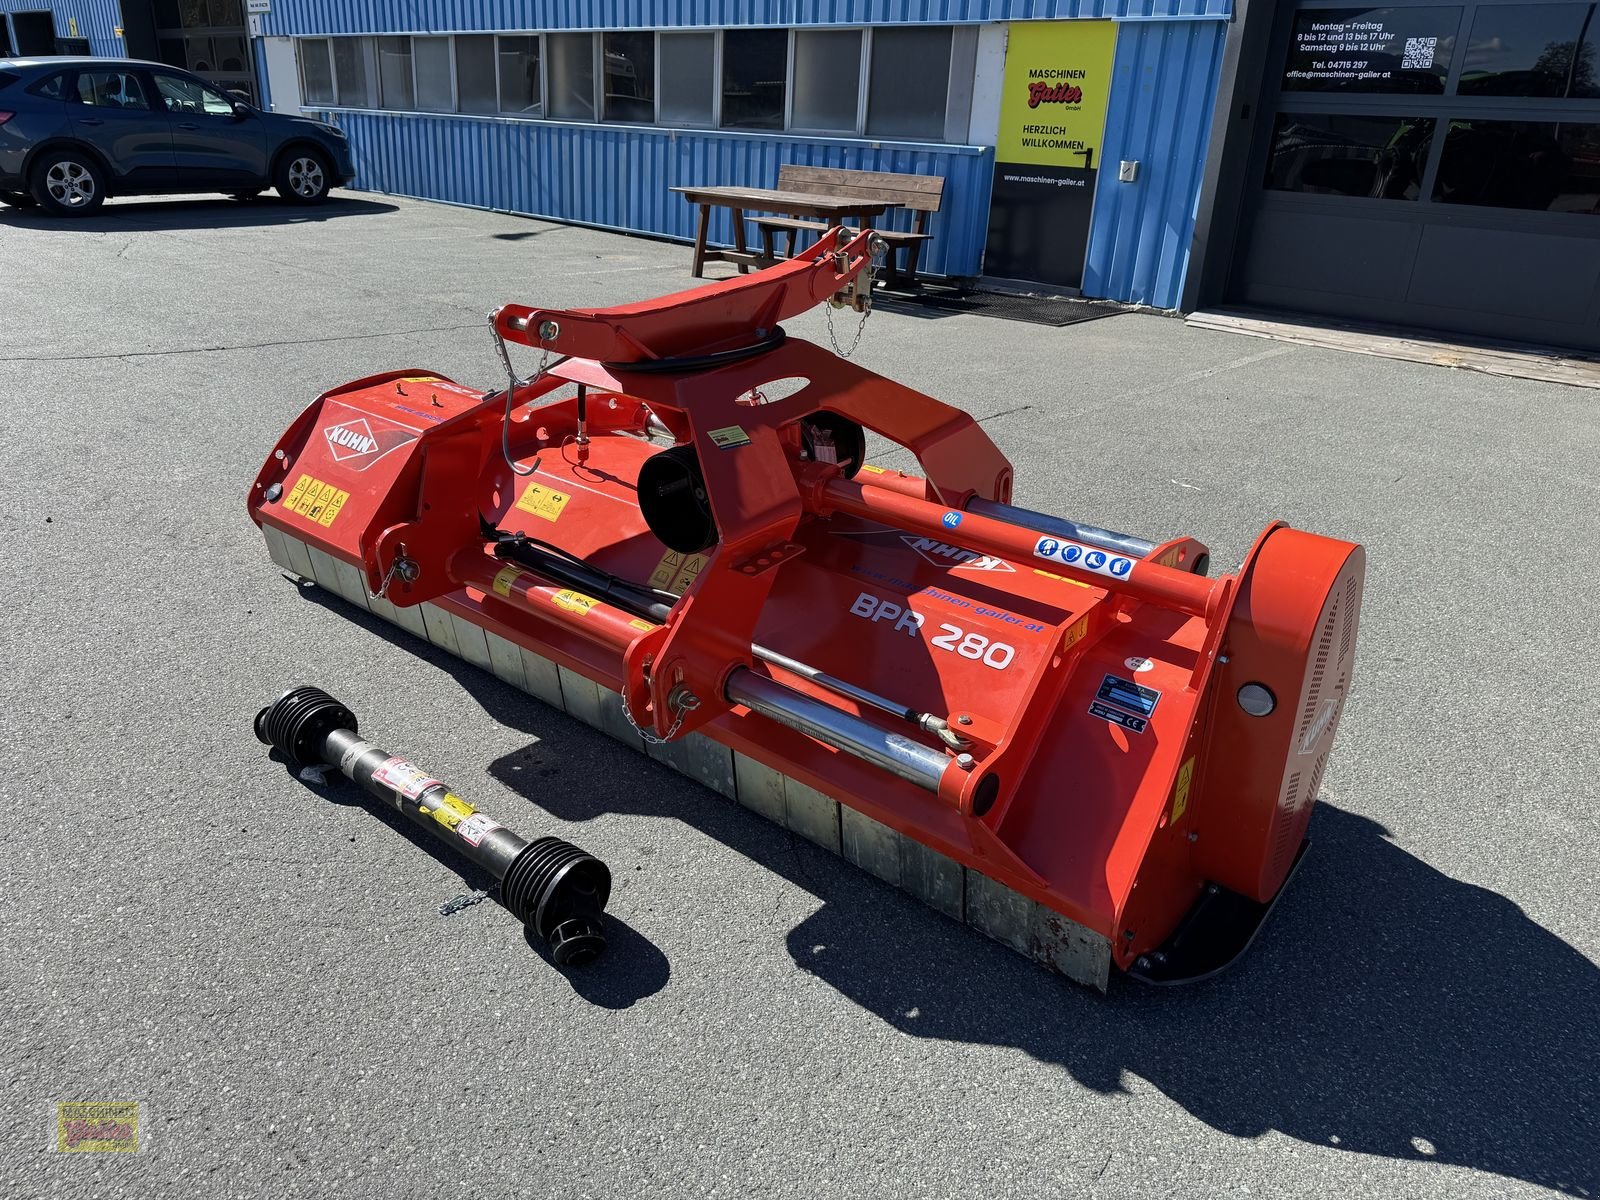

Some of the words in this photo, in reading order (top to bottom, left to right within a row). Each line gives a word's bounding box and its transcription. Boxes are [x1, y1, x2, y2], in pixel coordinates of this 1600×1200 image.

[1311, 23, 1345, 32] Montag
[1351, 21, 1384, 31] Freitag
[1297, 33, 1303, 41] 8
[1304, 33, 1317, 41] bis
[1318, 33, 1326, 41] 12
[1327, 33, 1344, 41] und
[1345, 33, 1354, 41] 13
[1355, 32, 1368, 41] bis
[1369, 32, 1378, 40] 17
[1379, 32, 1395, 40] Uhr
[1300, 43, 1338, 53] Samstag
[1339, 43, 1345, 51] 9
[1345, 42, 1359, 51] bis
[1360, 43, 1369, 51] 12
[1369, 43, 1386, 51] Uhr
[1312, 61, 1326, 69] Tel.
[1327, 61, 1352, 69] 04715
[1352, 61, 1368, 69] 297
[1028, 69, 1086, 79] MASCHINEN
[1028, 81, 1082, 109] Gailer
[1023, 125, 1066, 135] HERZLICH
[1021, 138, 1084, 150] WILLKOMMEN
[328, 425, 374, 454] KUHN
[944, 512, 958, 526] OIL
[911, 537, 1003, 570] KUHN
[849, 591, 925, 637] BPR
[930, 622, 1016, 670] 280
